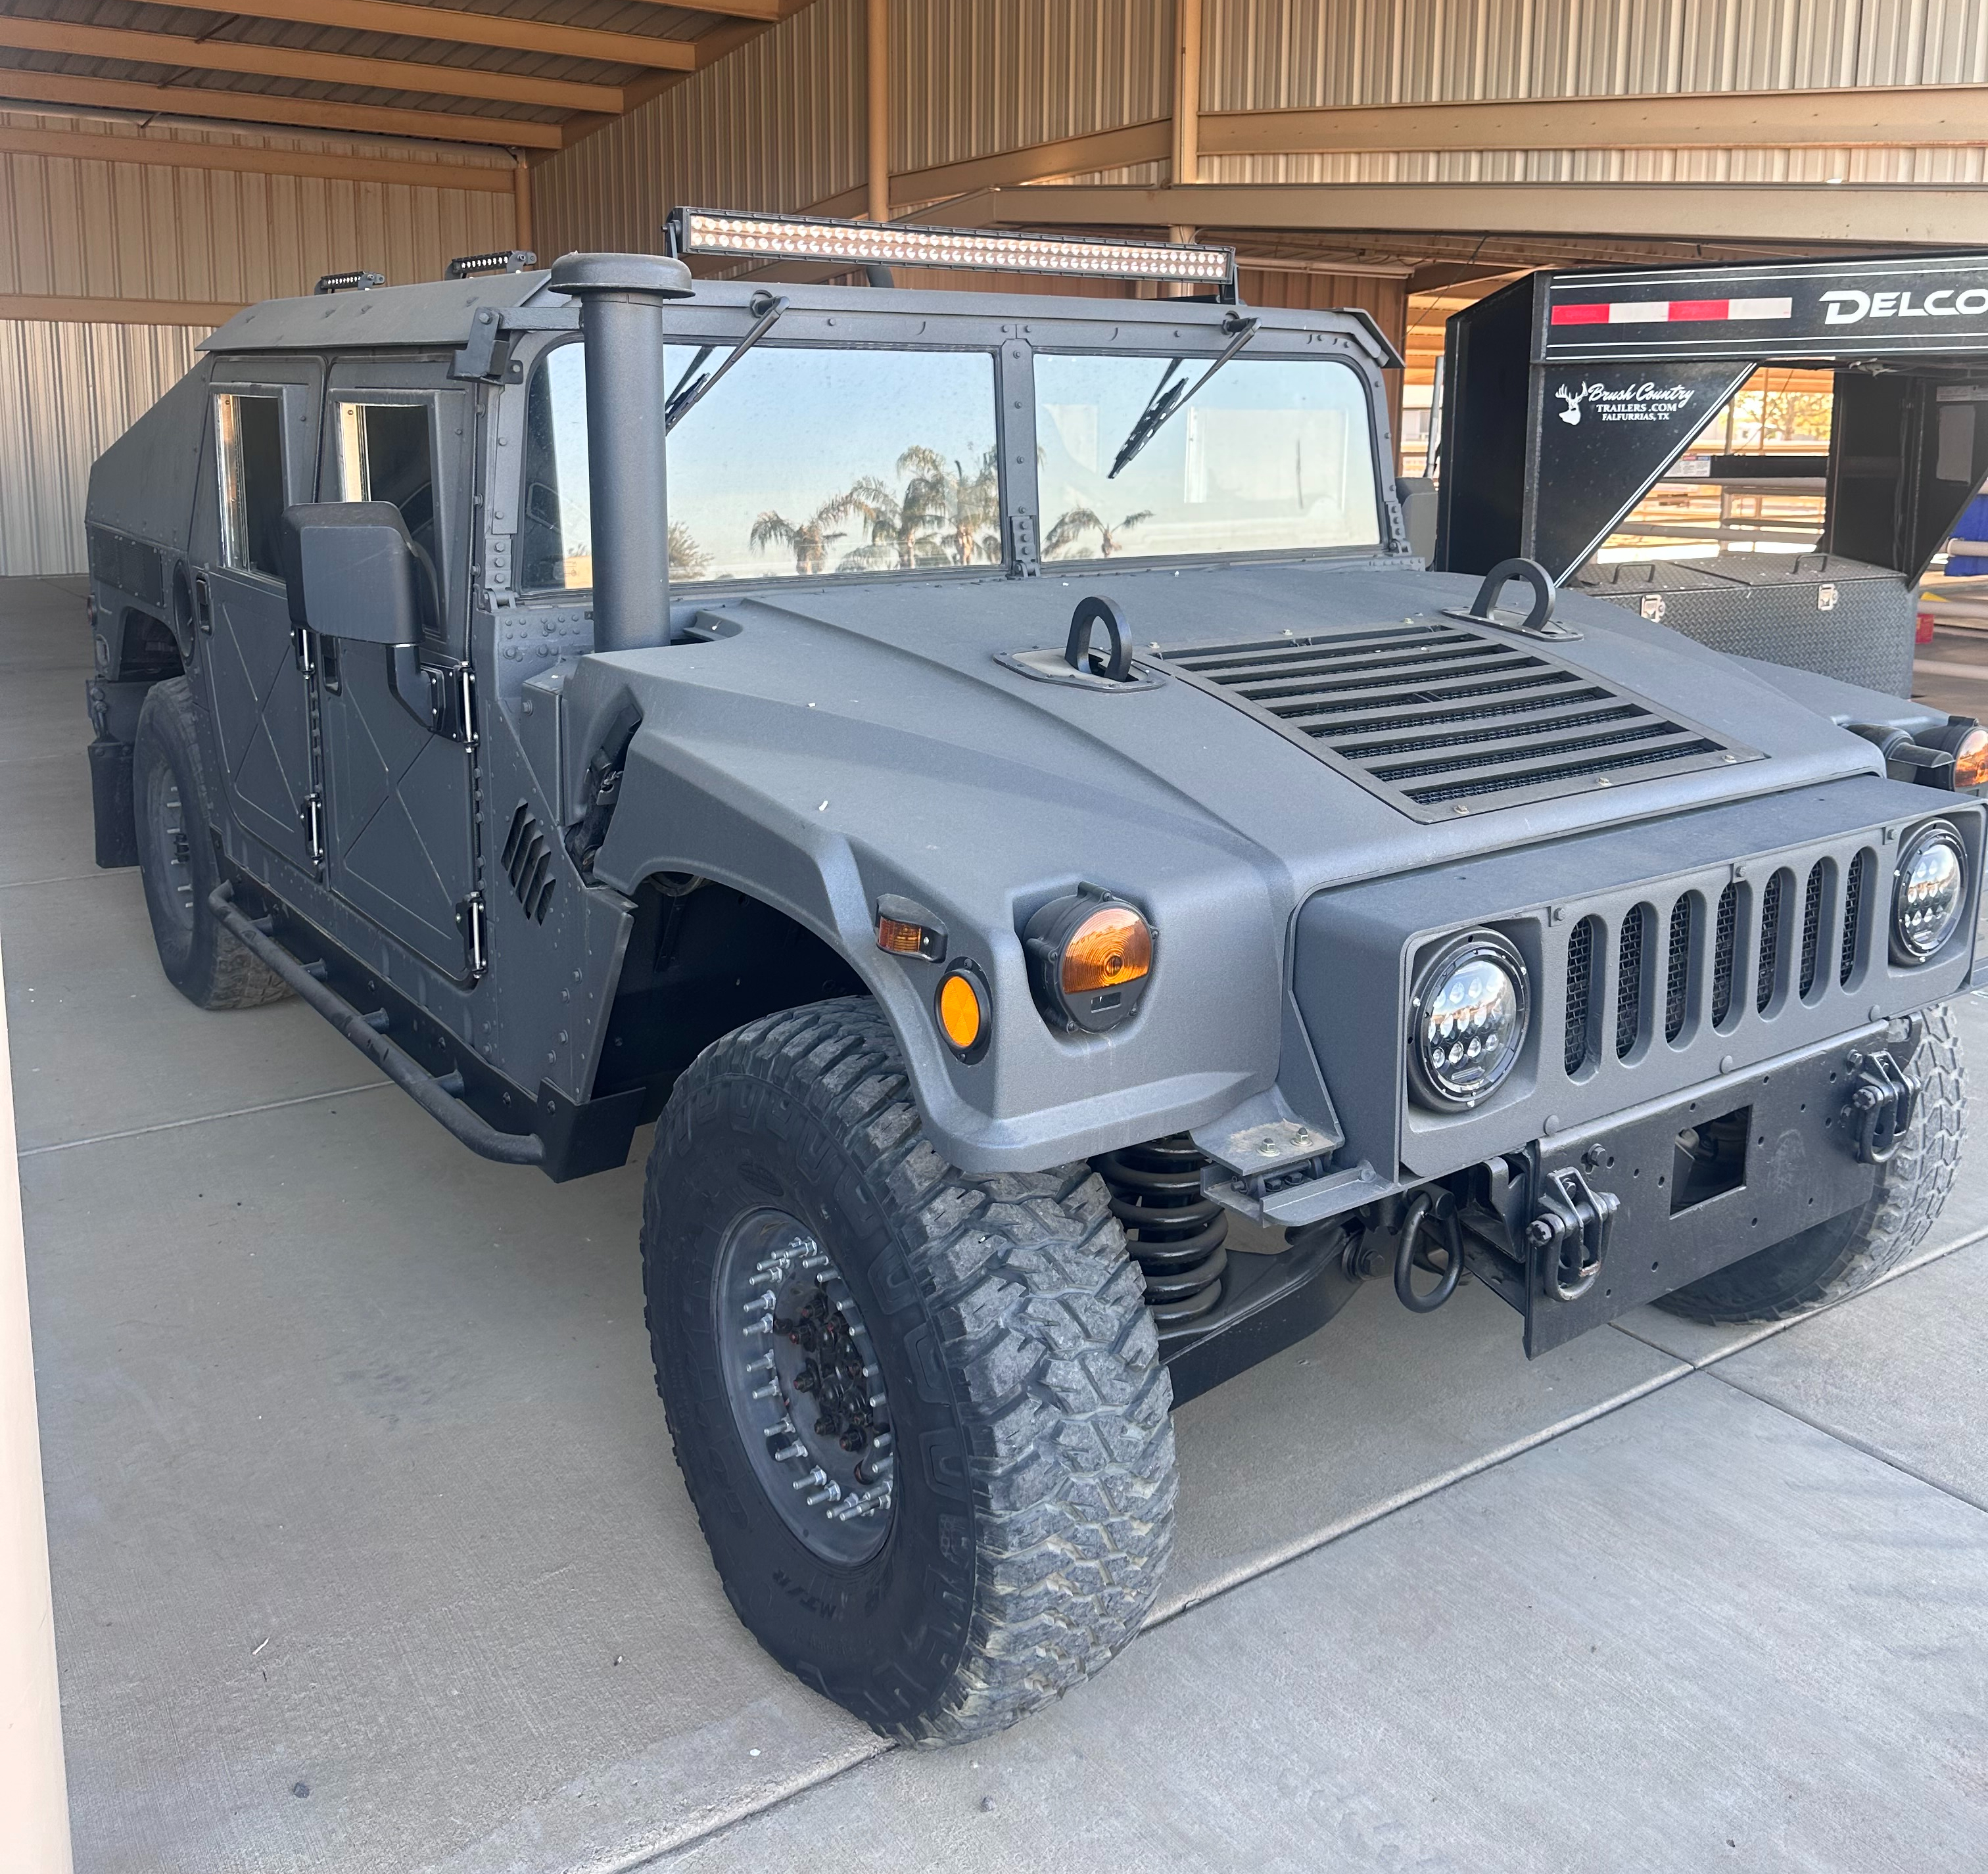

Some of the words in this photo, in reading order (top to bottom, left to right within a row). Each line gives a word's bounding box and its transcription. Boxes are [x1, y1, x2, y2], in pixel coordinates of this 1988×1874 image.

[1818, 289, 1988, 325] DELCO
[1588, 383, 1636, 402] Brush
[1636, 382, 1695, 408] Country
[1596, 404, 1647, 413] TRAILERS
[1648, 403, 1677, 412] .COM
